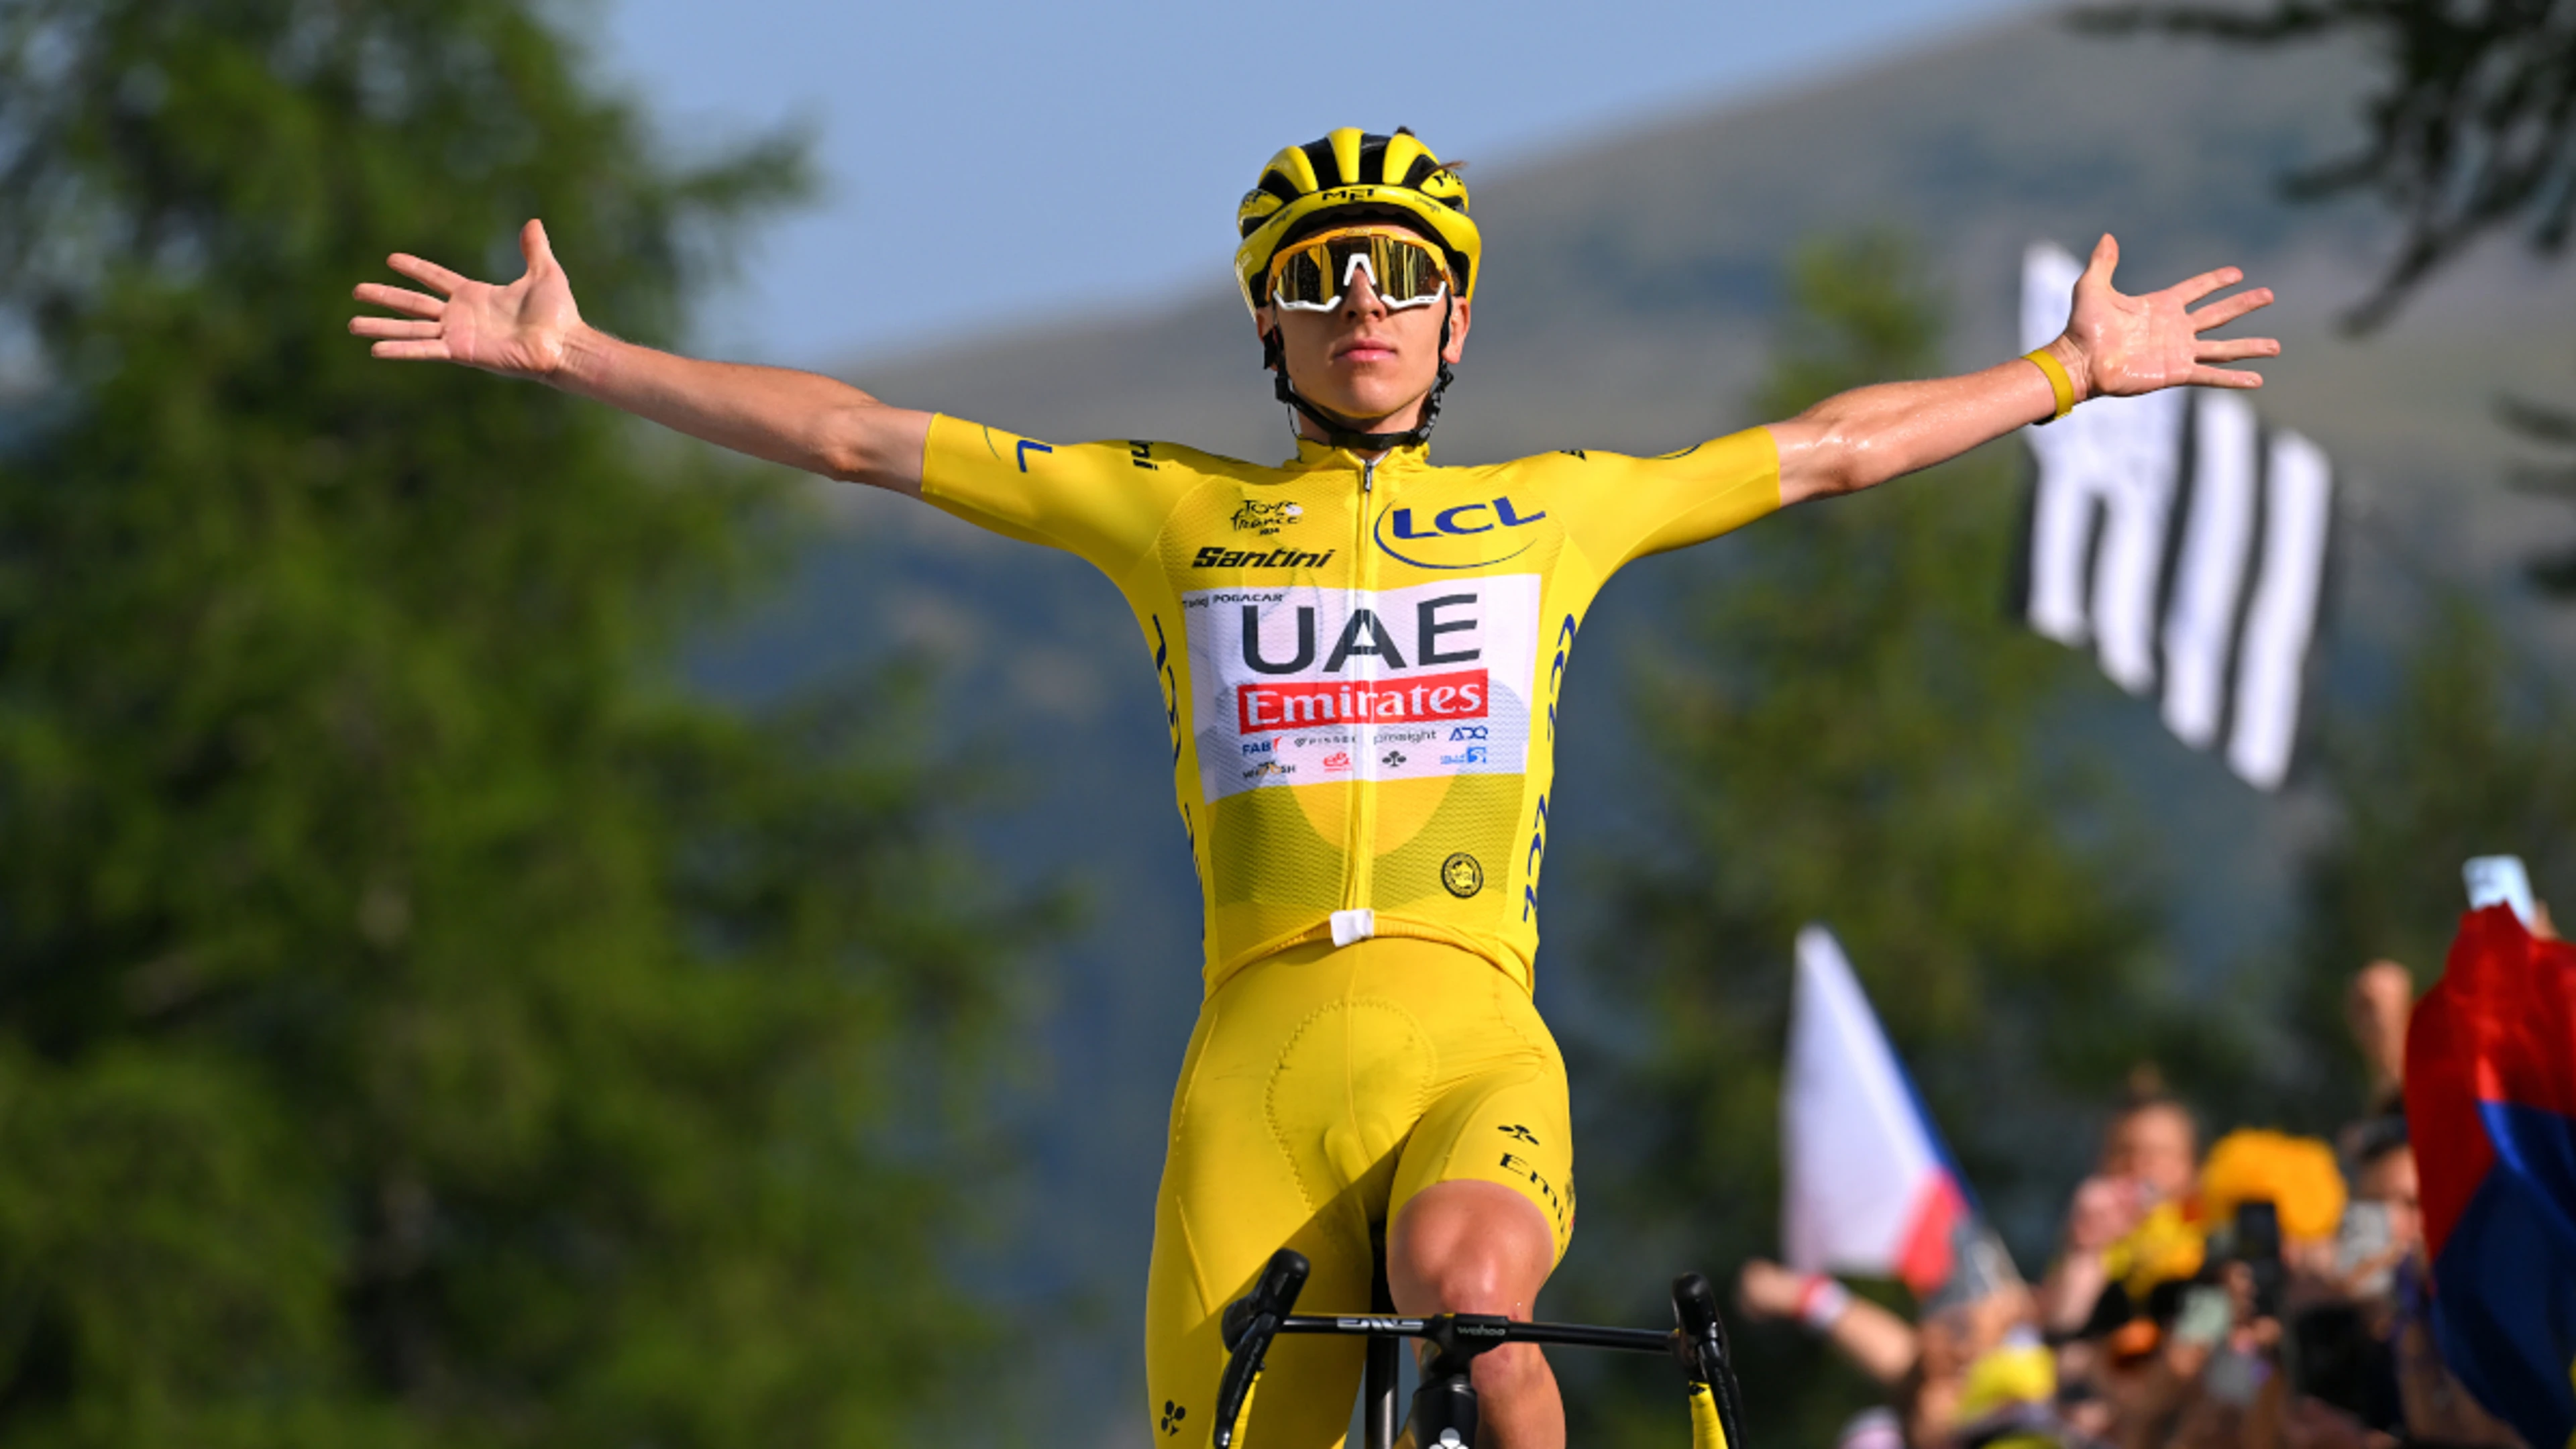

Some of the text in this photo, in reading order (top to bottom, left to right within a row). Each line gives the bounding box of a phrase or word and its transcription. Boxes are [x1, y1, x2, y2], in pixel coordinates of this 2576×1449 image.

[1393, 496, 1546, 539] LCL
[1191, 547, 1336, 568] Santini
[1242, 593, 1481, 675] UAE
[1245, 683, 1482, 727] Emirates
[1242, 741, 1271, 755] FAB
